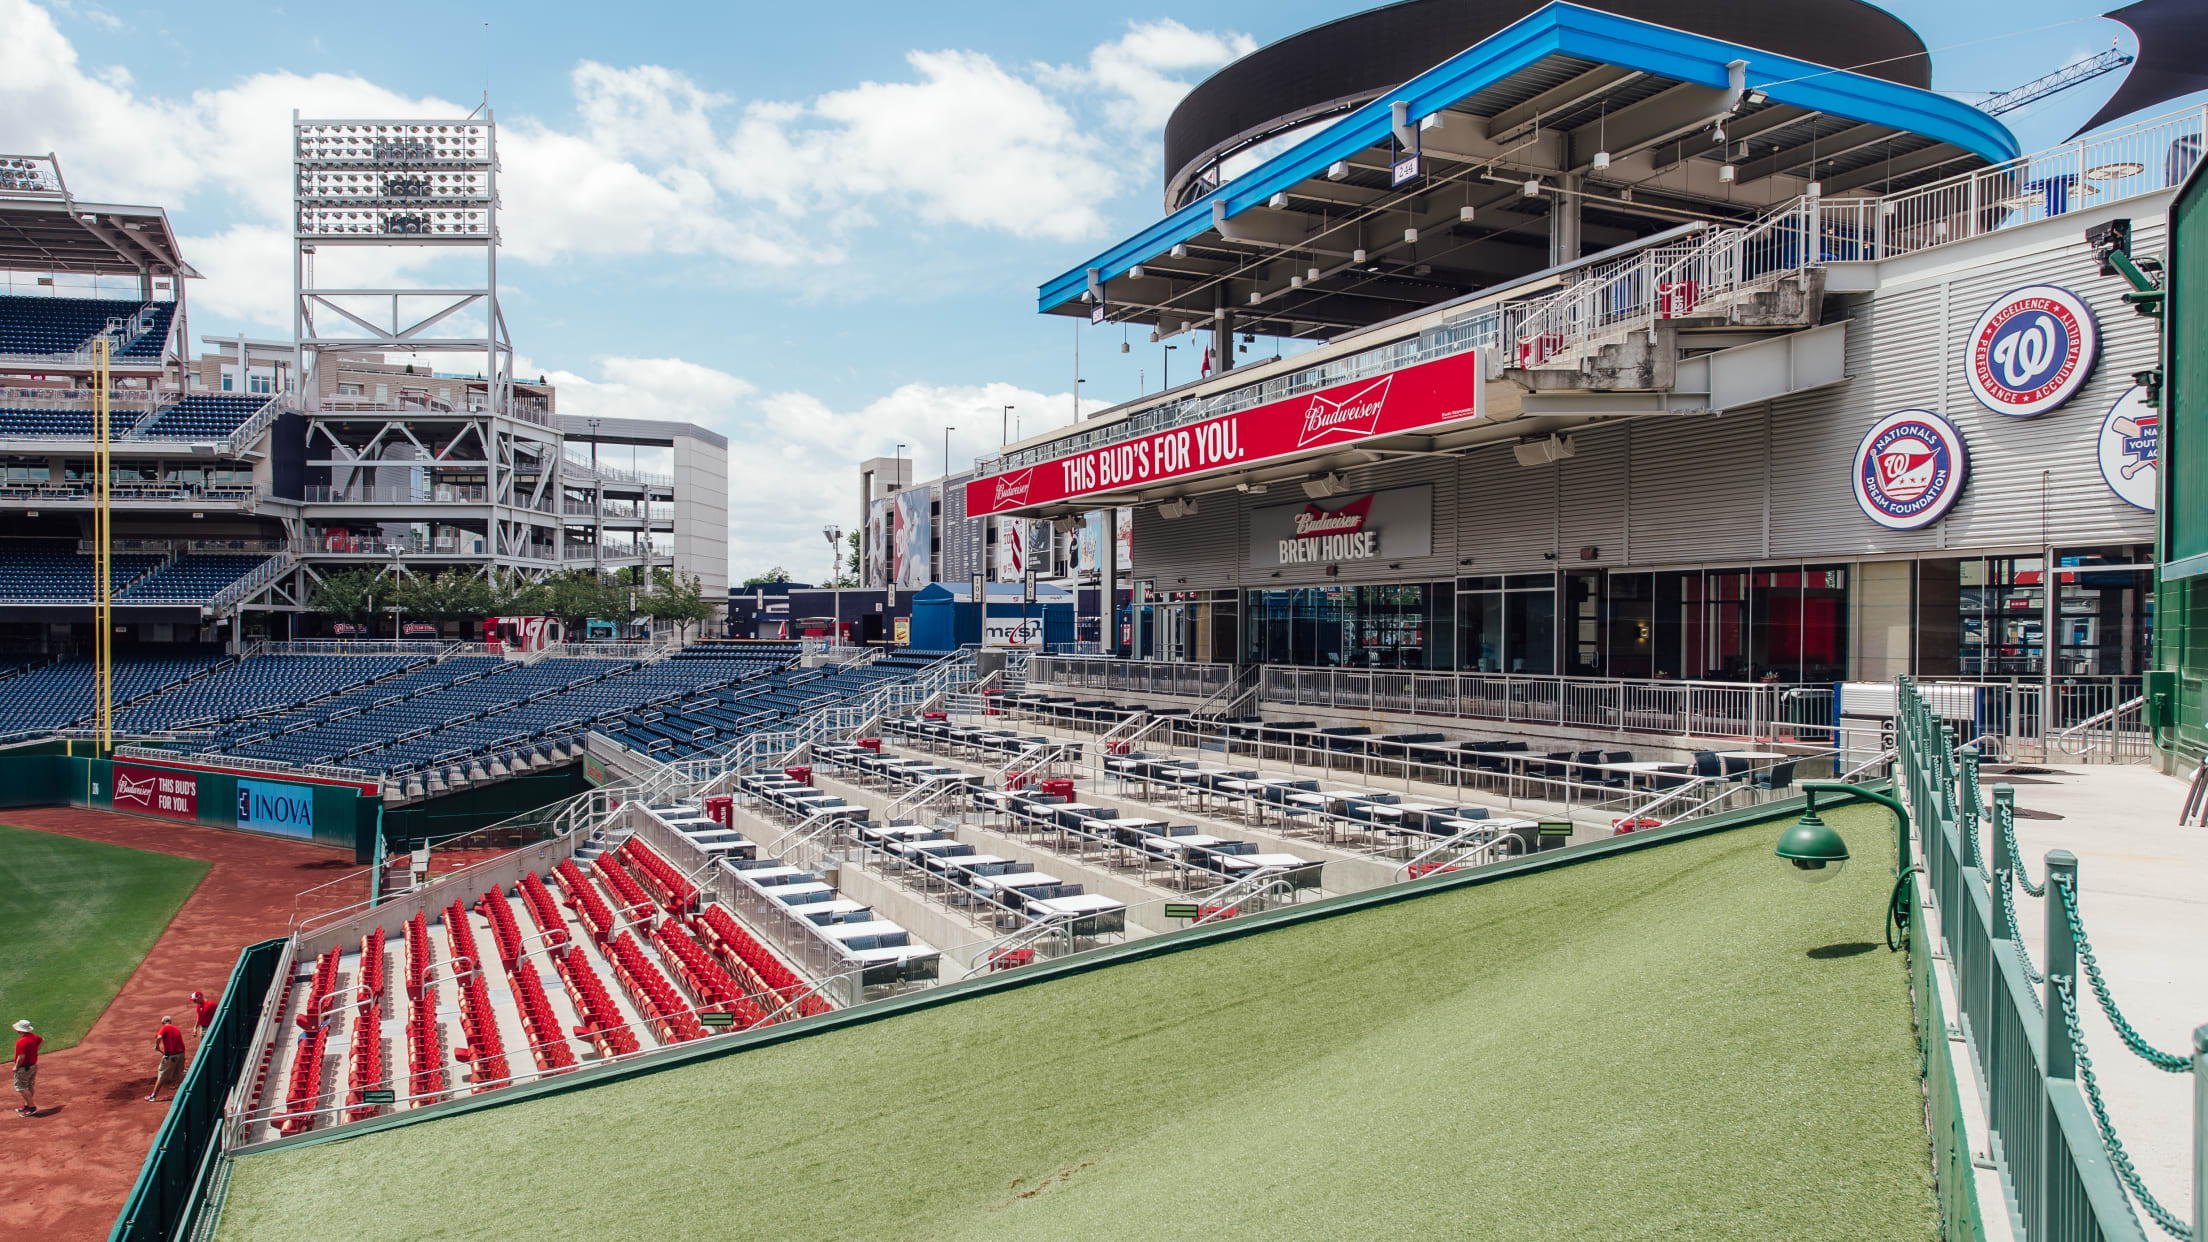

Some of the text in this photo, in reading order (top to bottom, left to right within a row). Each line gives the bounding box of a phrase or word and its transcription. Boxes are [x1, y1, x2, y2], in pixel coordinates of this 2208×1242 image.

[1399, 162, 1413, 178] 244
[1991, 299, 2051, 327] EXCELLENCE
[2035, 312, 2080, 399] ACCOUNTABILITY
[1976, 339, 2018, 403] PERFORMANCE
[1305, 400, 1382, 432] Budweiser
[1876, 426, 1938, 450] NATIONALS
[2129, 439, 2158, 449] YOUT
[1062, 417, 1245, 494] THIS BUD'S FOR YOU.
[995, 480, 1029, 501] Budweiser
[1866, 469, 1947, 513] DREAM FOUNDATION
[1295, 511, 1361, 535] Budweiser
[1279, 531, 1376, 564] BREW HOUSE
[118, 780, 152, 796] Budweiser
[158, 778, 196, 796] THIS BUD'S
[158, 795, 189, 812] FOR YOU.
[256, 794, 312, 826] INOVA
